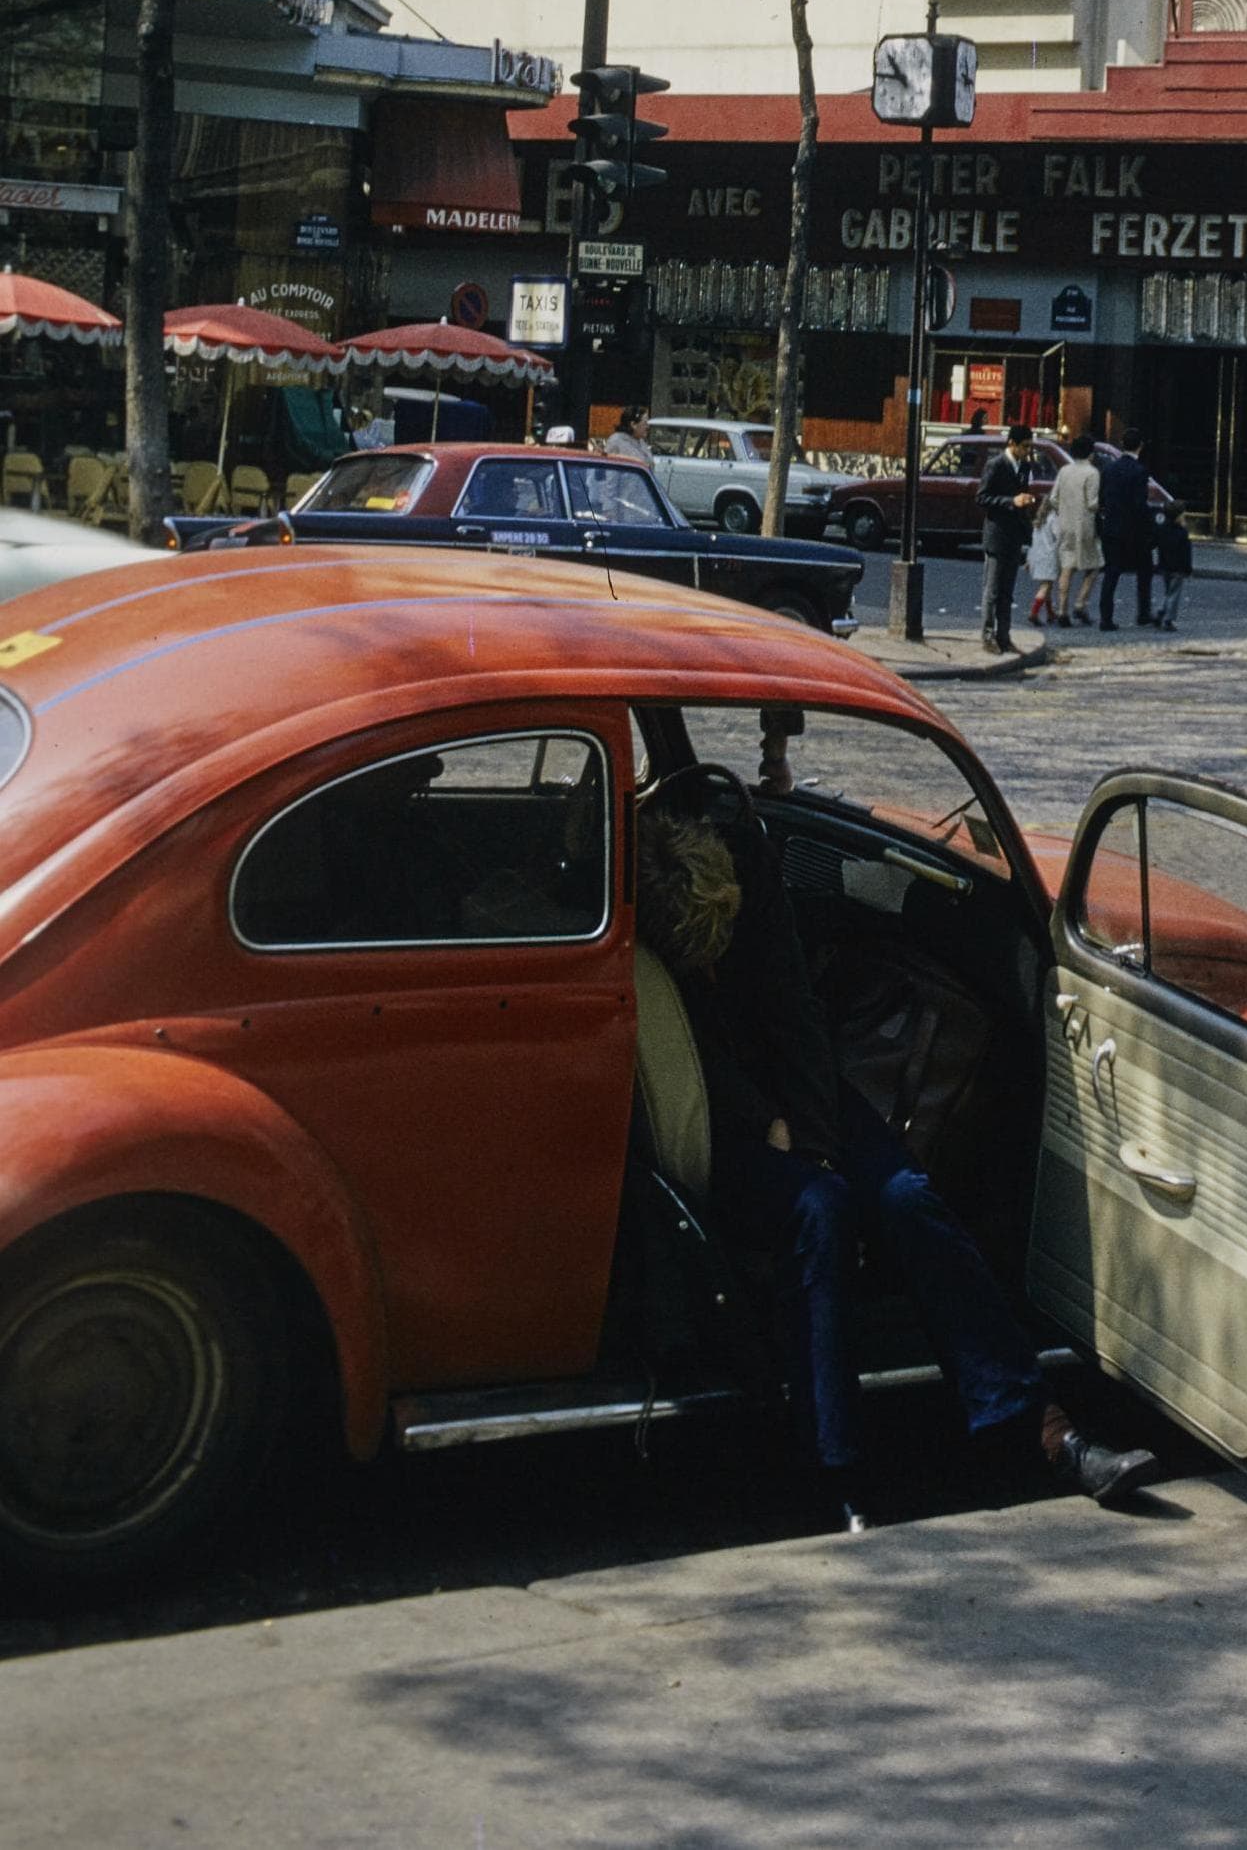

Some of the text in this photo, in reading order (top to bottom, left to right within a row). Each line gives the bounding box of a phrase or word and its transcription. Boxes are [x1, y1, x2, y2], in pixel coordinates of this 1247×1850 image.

[687, 154, 1148, 216] AVEC PETER FALK
[584, 244, 626, 256] BOULEVARD
[250, 283, 335, 310] AU COMPTOIR
[520, 294, 558, 312] TAXIS
